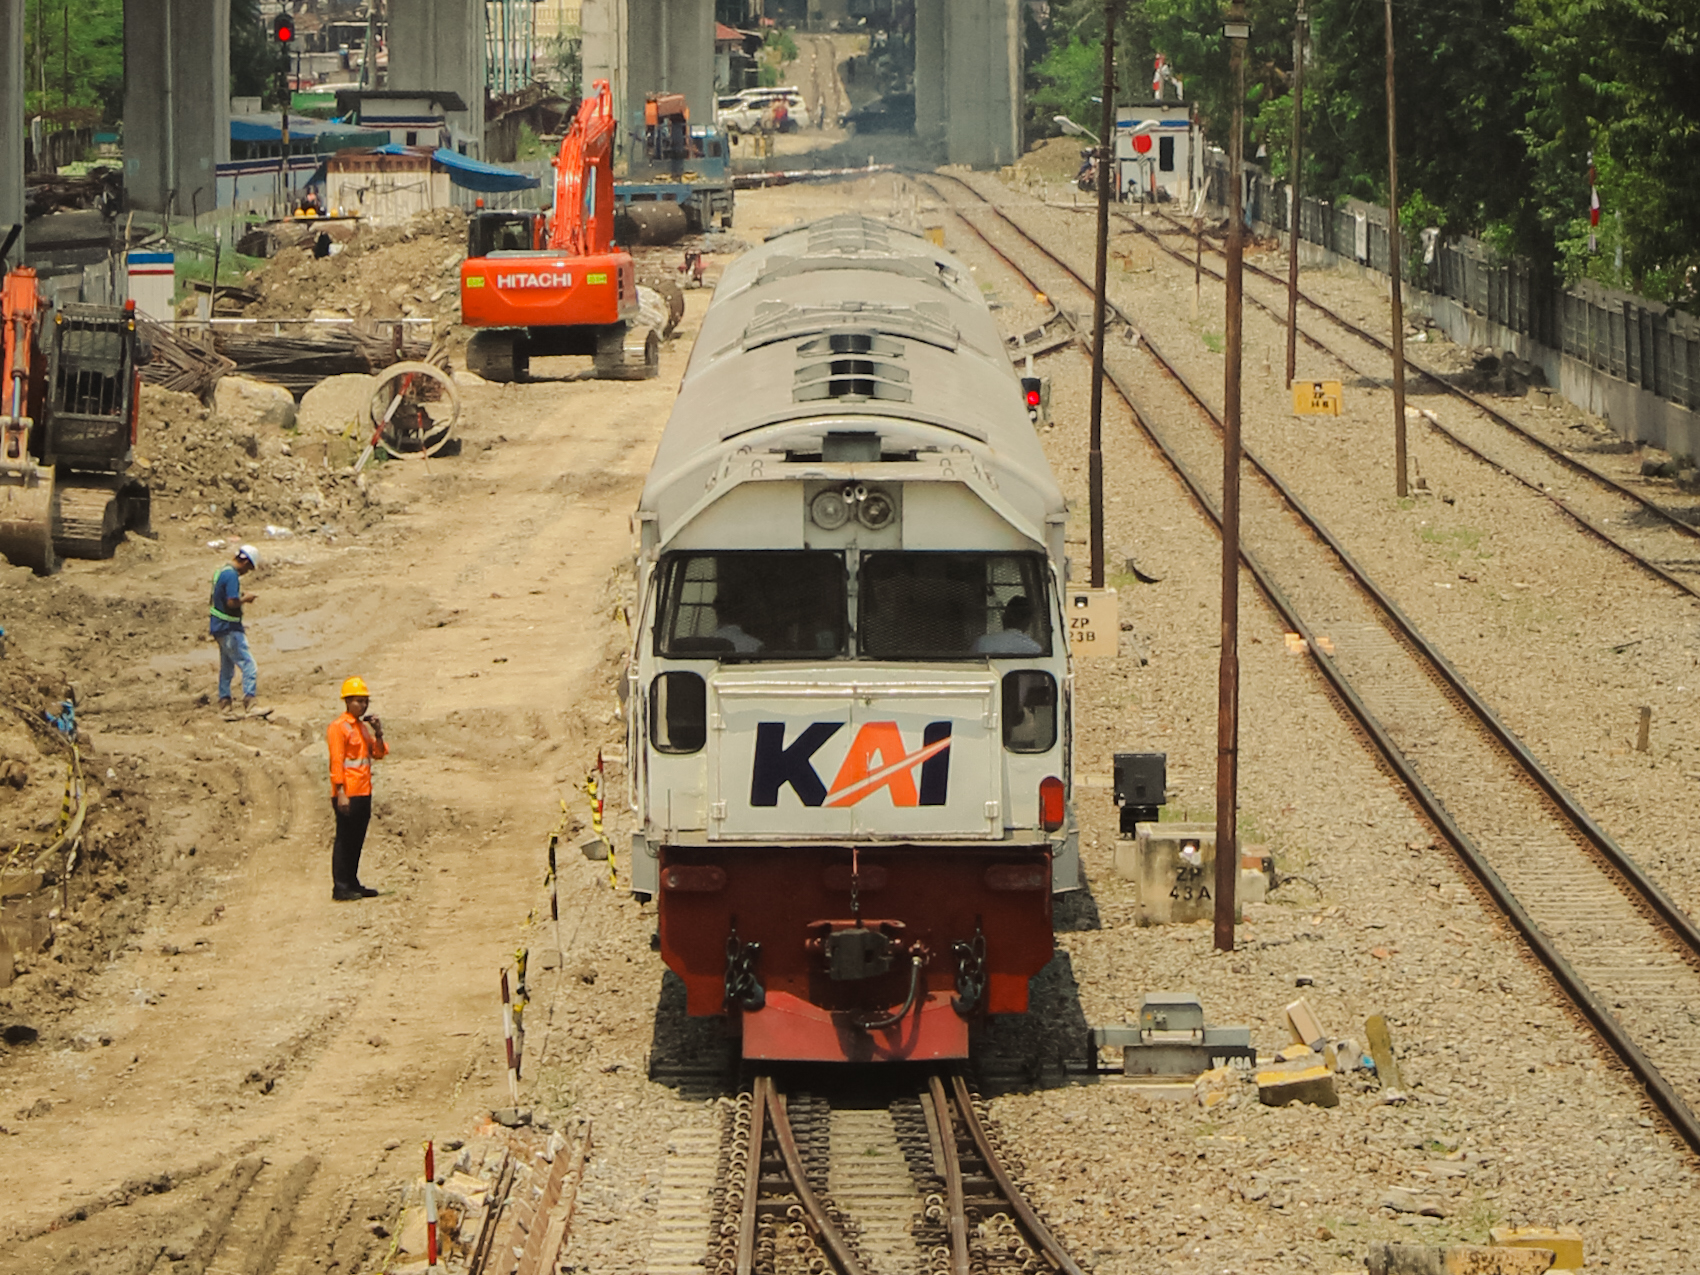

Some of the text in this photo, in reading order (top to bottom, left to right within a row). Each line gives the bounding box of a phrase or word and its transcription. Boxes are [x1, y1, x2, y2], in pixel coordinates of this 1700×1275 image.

[497, 273, 571, 288] HITACHI
[1070, 618, 1089, 629] ZP
[750, 721, 953, 808] KAI
[1176, 867, 1202, 882] ZP
[1169, 886, 1212, 901] 43A
